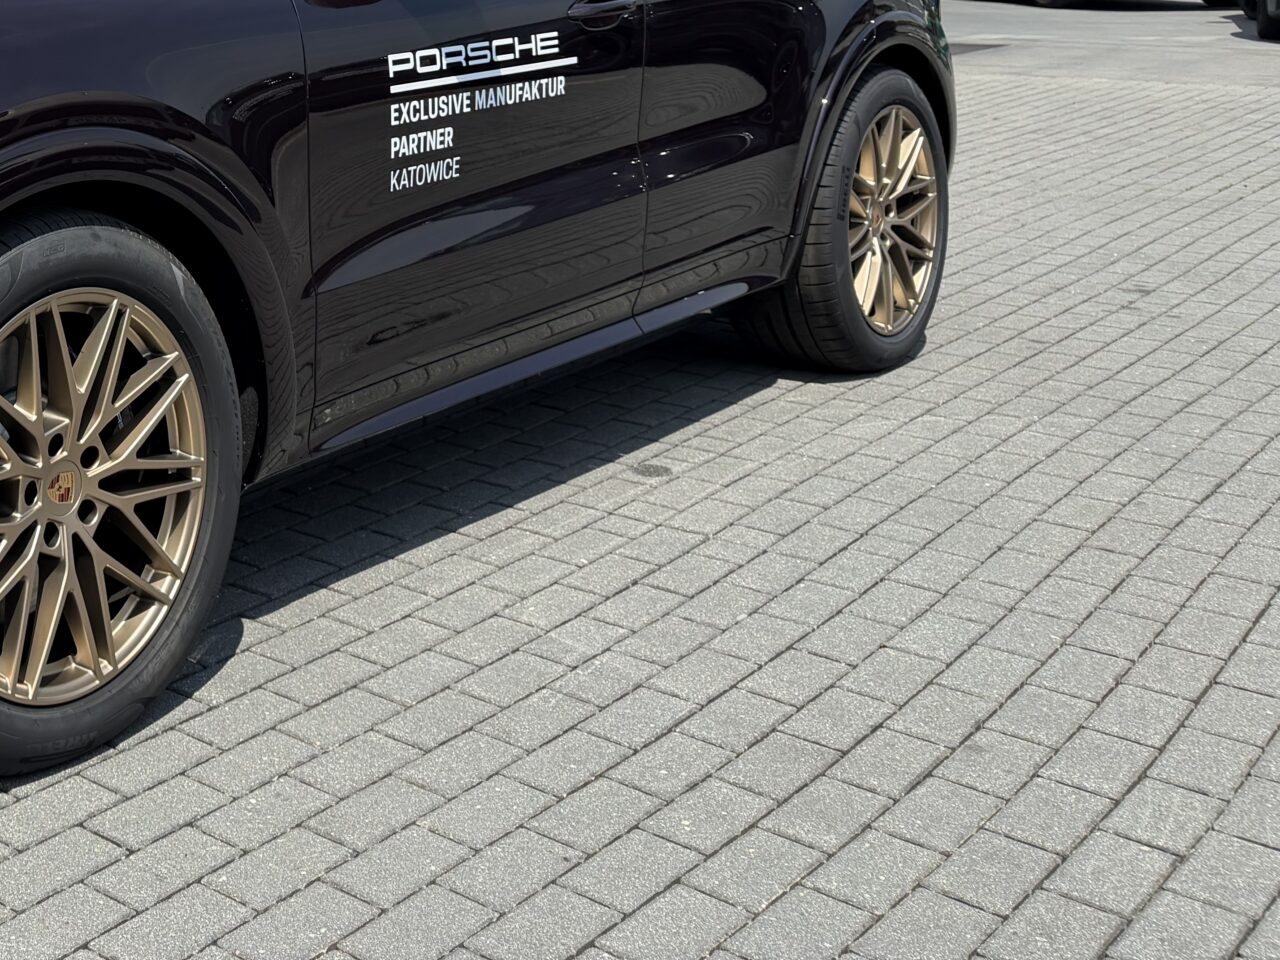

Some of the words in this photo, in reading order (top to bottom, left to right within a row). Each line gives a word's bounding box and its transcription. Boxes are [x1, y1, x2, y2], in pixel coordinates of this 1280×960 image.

[387, 31, 560, 78] PORSCHE
[390, 92, 471, 126] EXCLUSIVE
[474, 75, 566, 111] MANUFAKTUR
[390, 126, 454, 159] PARTNER
[390, 156, 461, 192] KATOWICE
